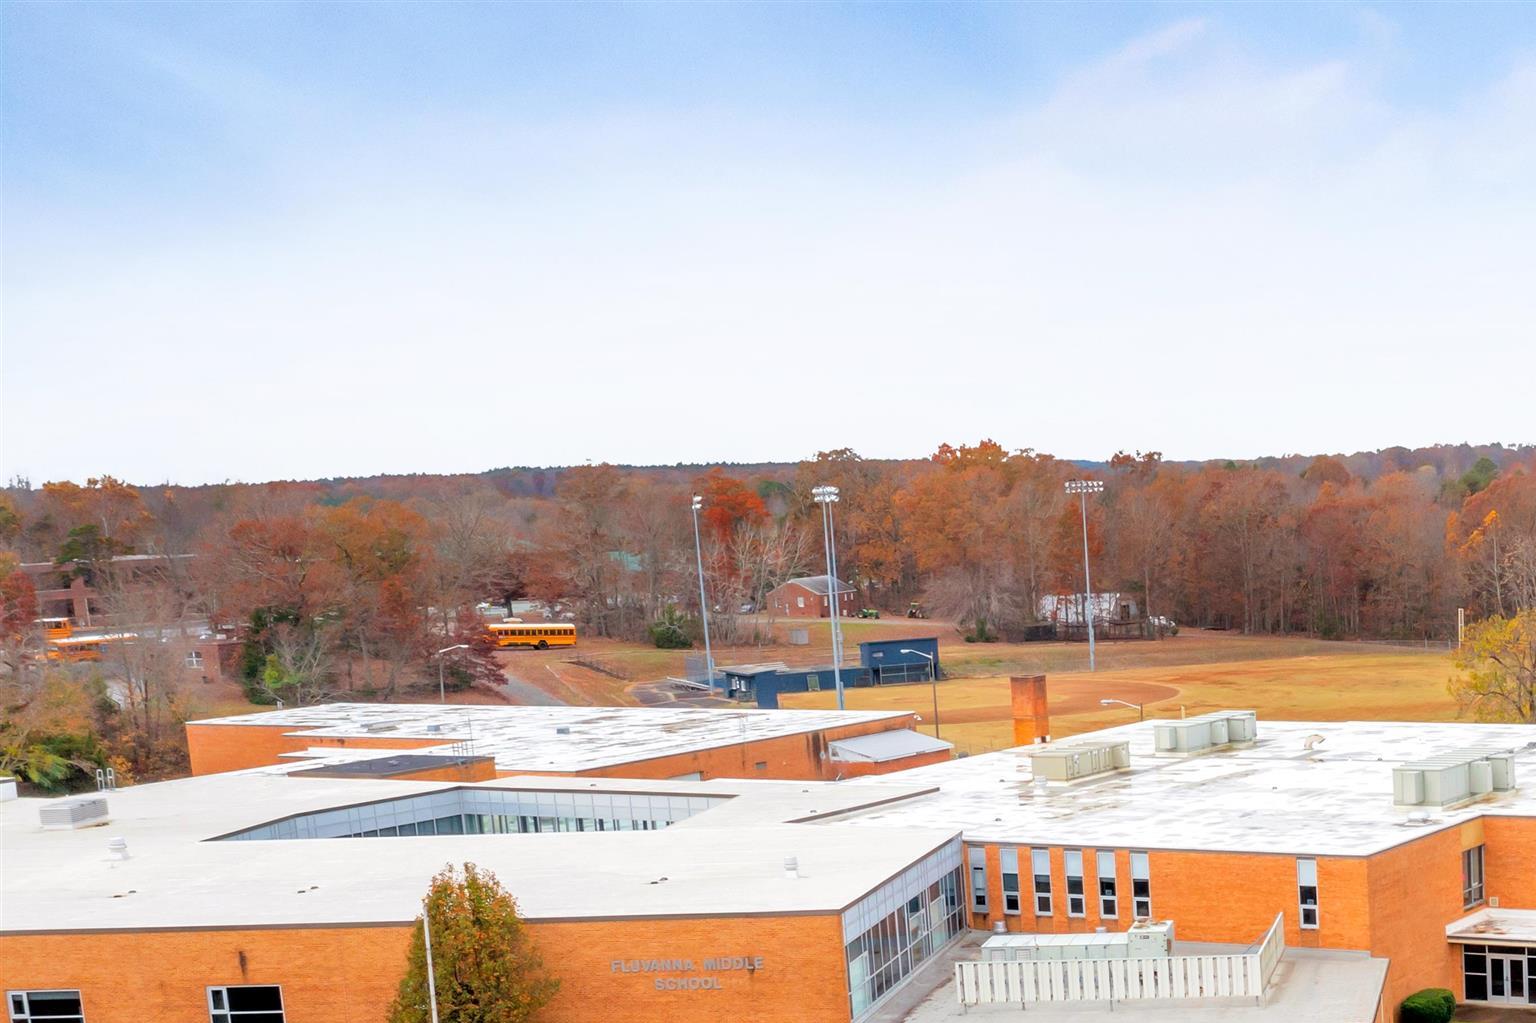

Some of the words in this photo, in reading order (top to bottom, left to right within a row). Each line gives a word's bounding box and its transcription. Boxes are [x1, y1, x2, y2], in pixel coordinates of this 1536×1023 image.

[611, 958, 694, 973] FLUVANNA
[704, 956, 764, 971] MIDDLE
[655, 976, 721, 991] SCHOOL
